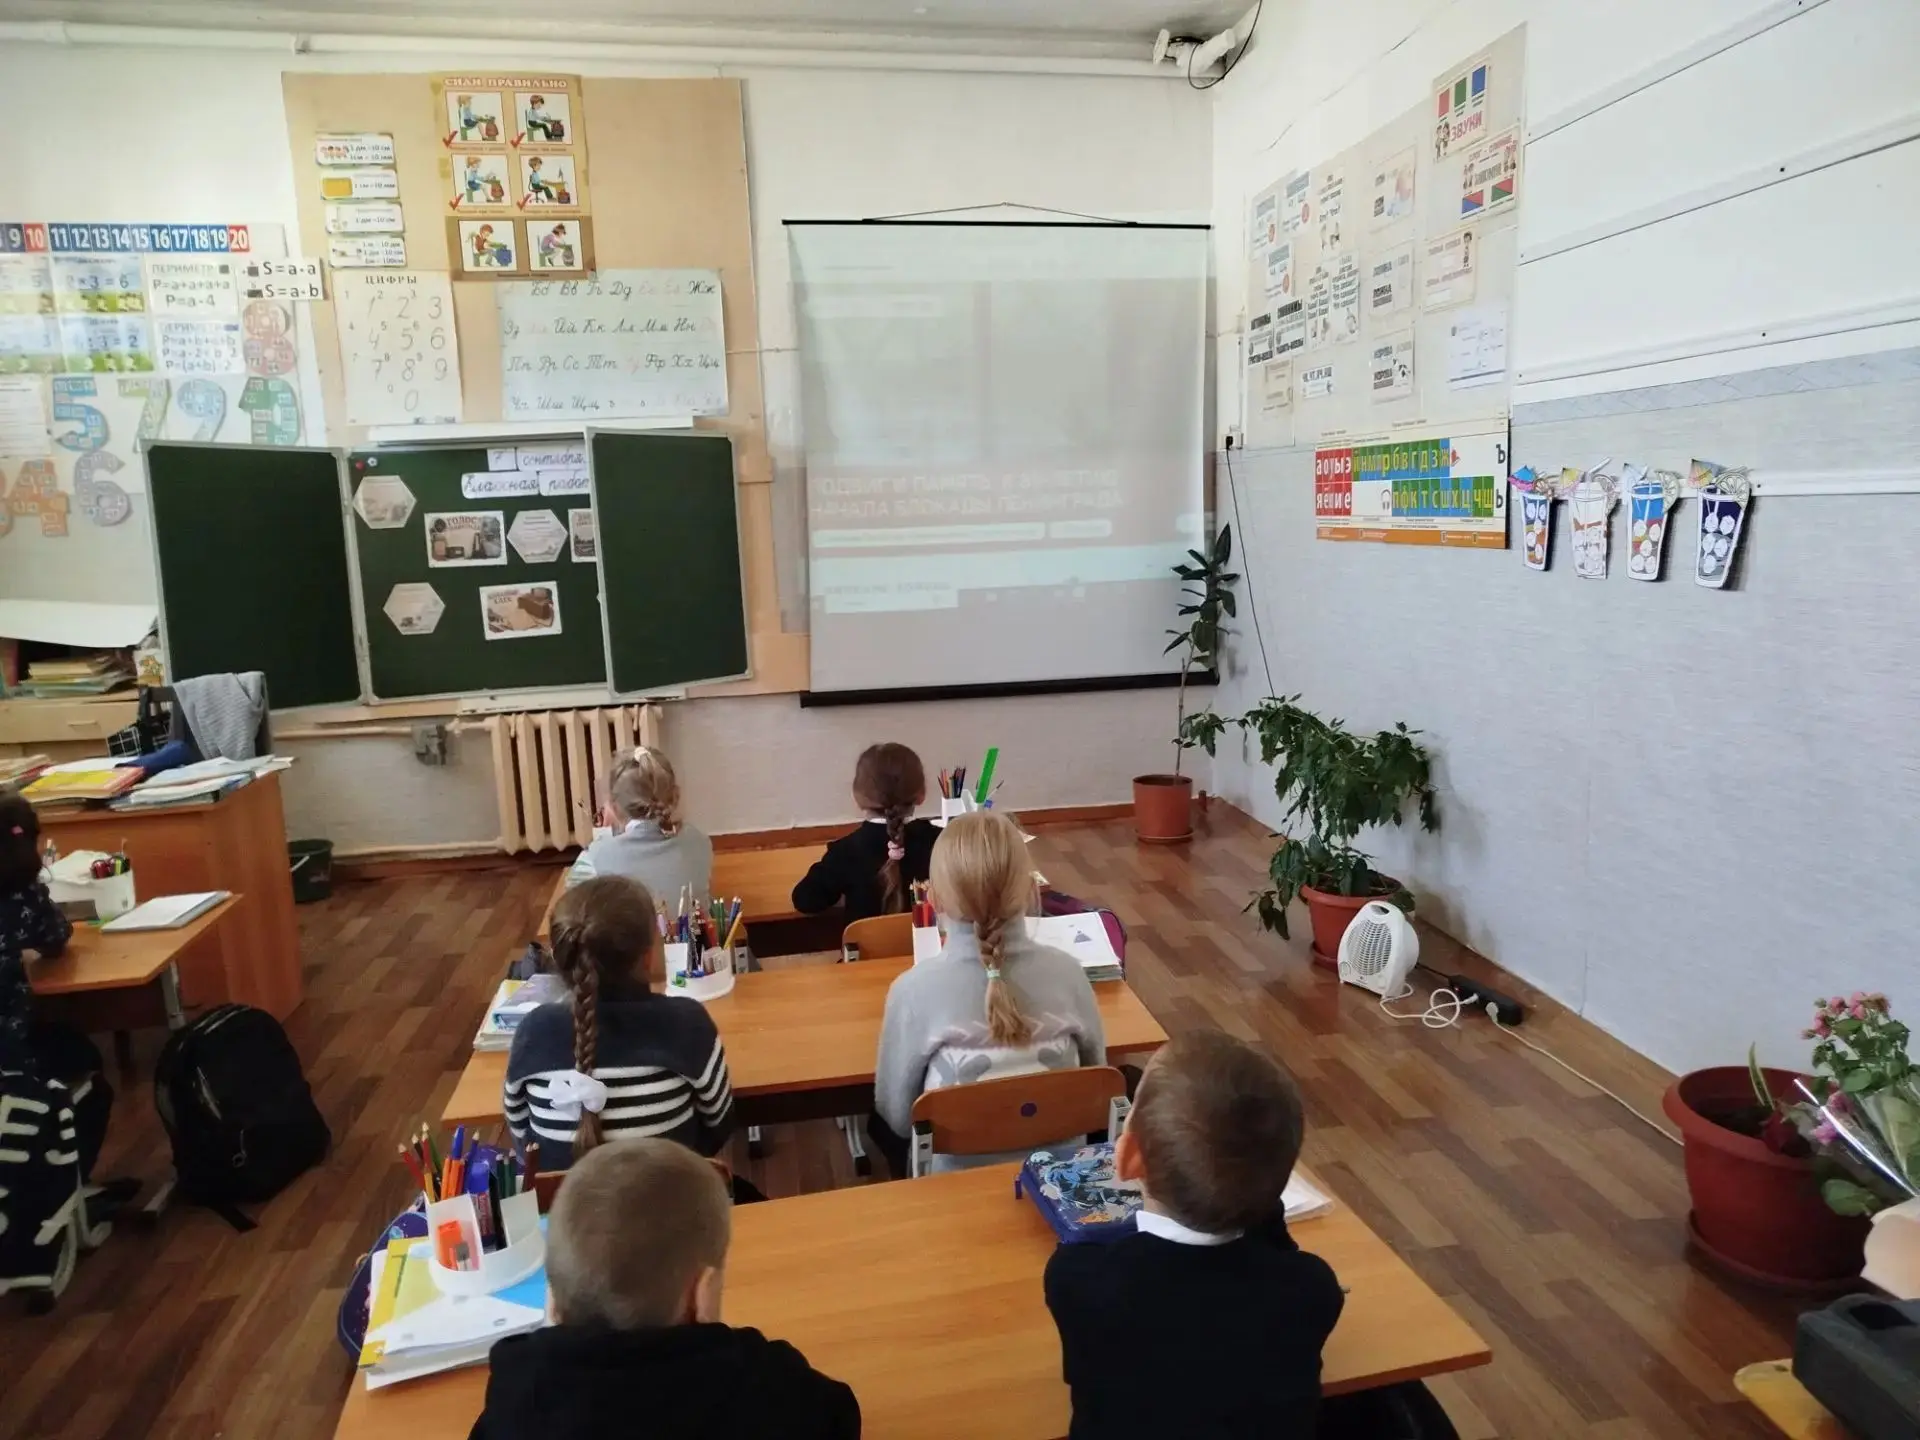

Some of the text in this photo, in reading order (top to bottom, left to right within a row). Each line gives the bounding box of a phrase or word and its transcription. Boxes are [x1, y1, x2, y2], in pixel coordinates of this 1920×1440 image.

[444, 77, 568, 88] СИДИ ПРАВИЛЬНО
[1450, 111, 1482, 141] ЗВУКИ
[9, 228, 249, 250] 9 10 11 12 13 14 15 16 17 18 19 20
[365, 275, 417, 285] ЦИФРЫ
[428, 295, 442, 320] 3
[430, 326, 446, 350] 6
[402, 358, 416, 382] 8
[435, 357, 448, 382] 9
